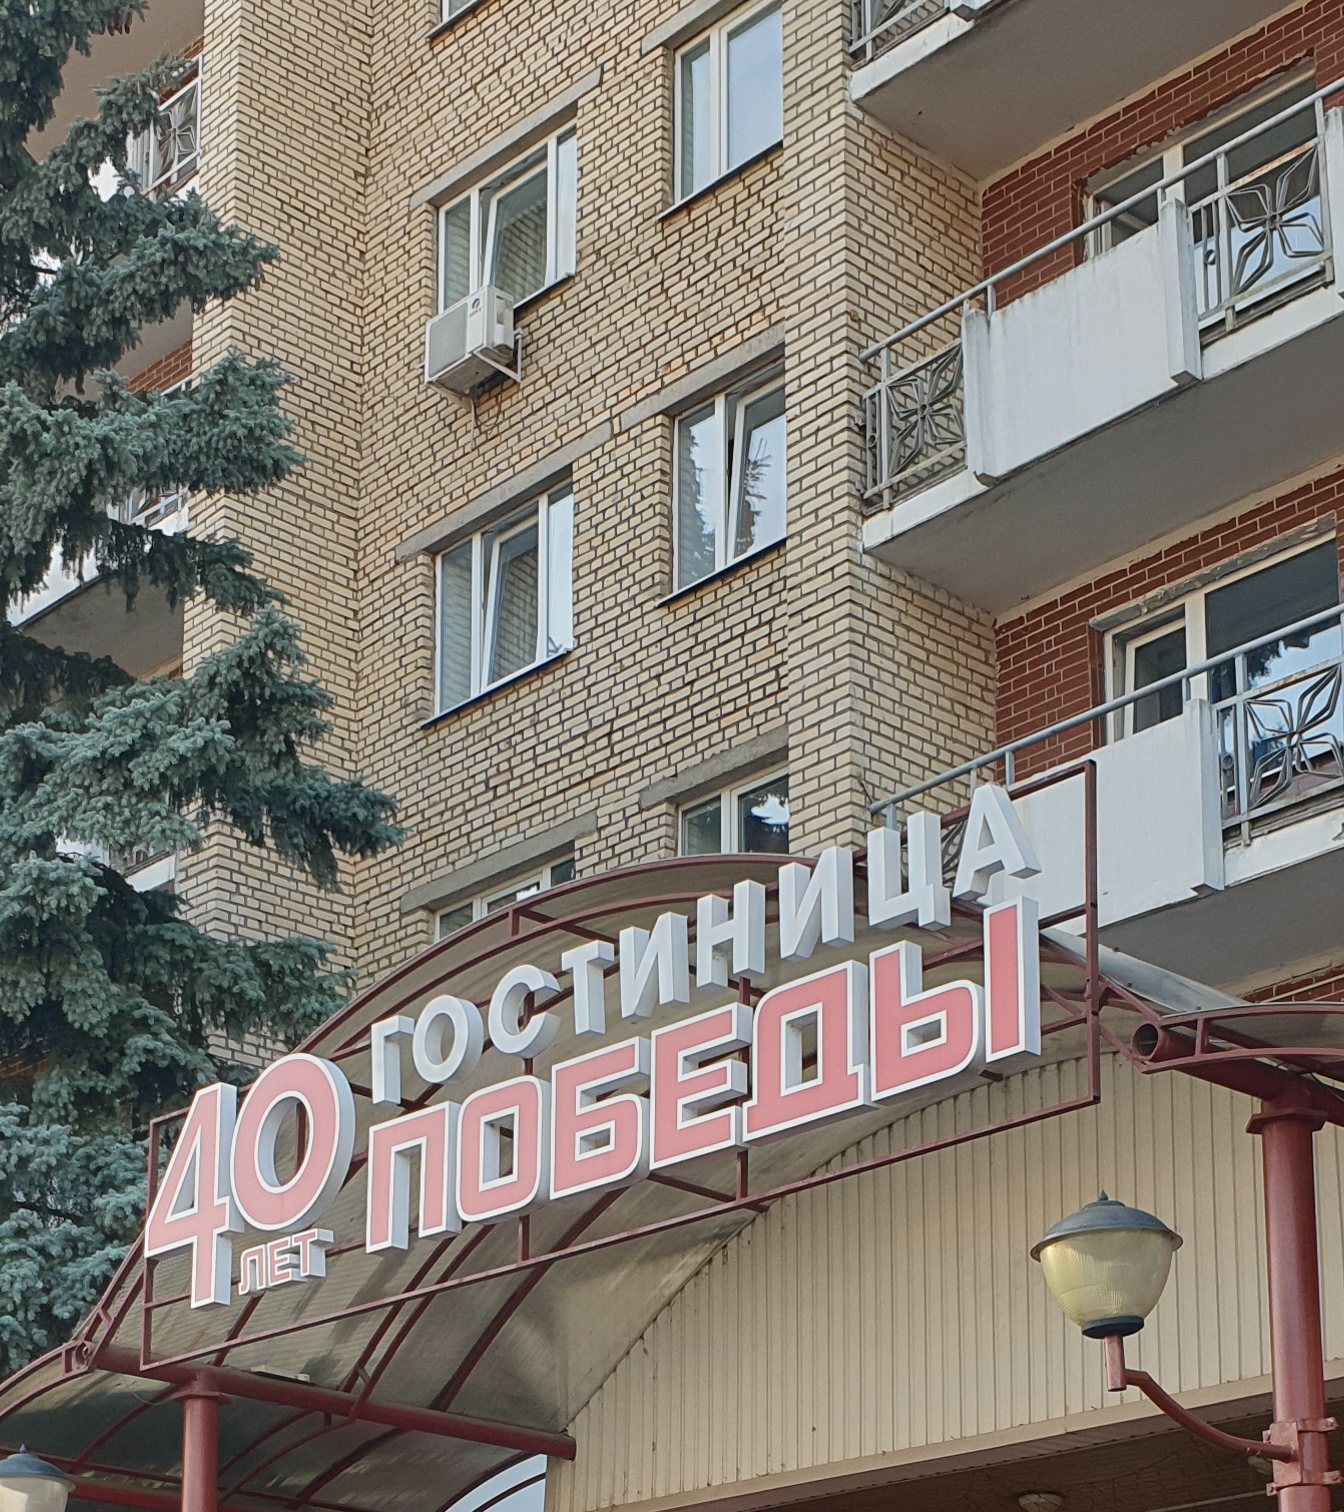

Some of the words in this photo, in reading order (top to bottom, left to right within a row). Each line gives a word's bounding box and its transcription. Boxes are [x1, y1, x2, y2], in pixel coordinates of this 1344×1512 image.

[365, 896, 1041, 1254] ПОБЕДЫ
[370, 784, 1041, 1106] ГОСТИНИЦА
[145, 1053, 355, 1309] 40
[239, 1228, 334, 1295] ЛЕТ
